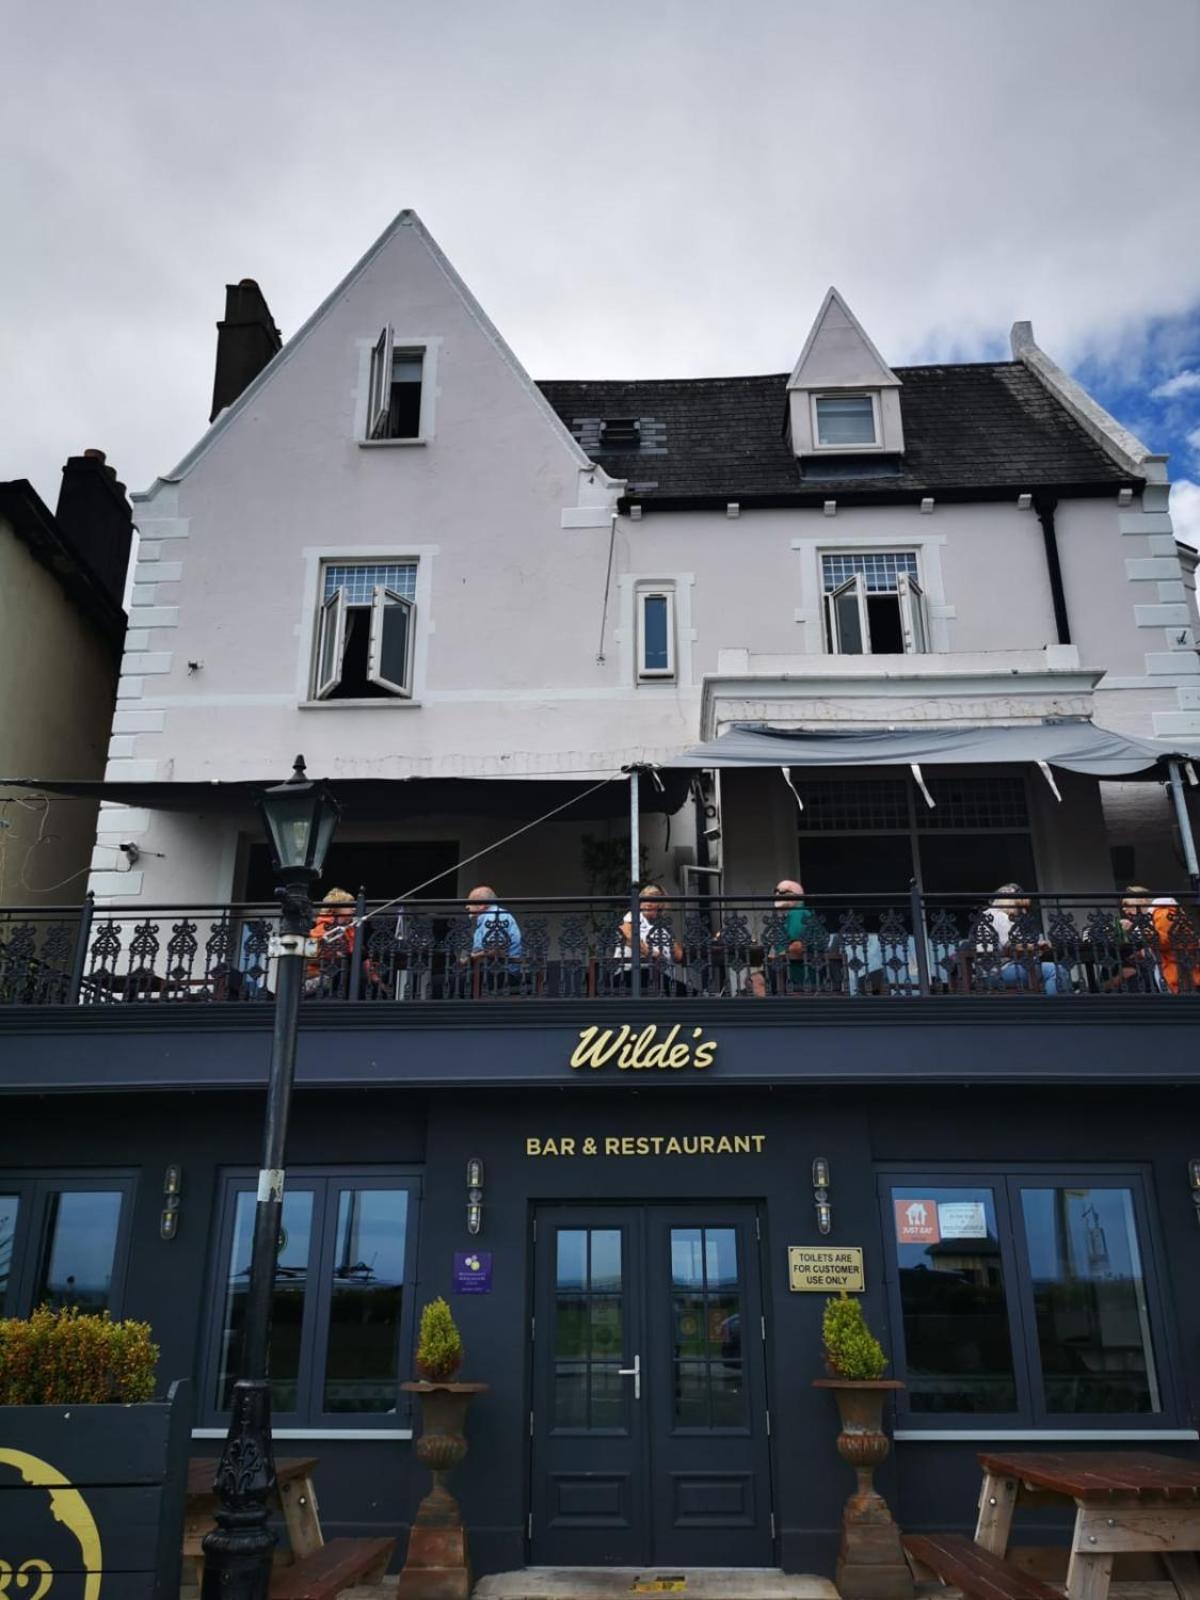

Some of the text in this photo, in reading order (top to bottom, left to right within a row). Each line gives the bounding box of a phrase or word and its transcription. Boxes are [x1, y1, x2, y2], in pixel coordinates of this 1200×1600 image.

[570, 1024, 717, 1068] Wilde's
[525, 1135, 766, 1156] BAR & RESTAURANT
[800, 1253, 852, 1262] TOILETS ARE
[794, 1264, 860, 1274] FOR CUSTOMER
[806, 1276, 848, 1285] USE ONLY
